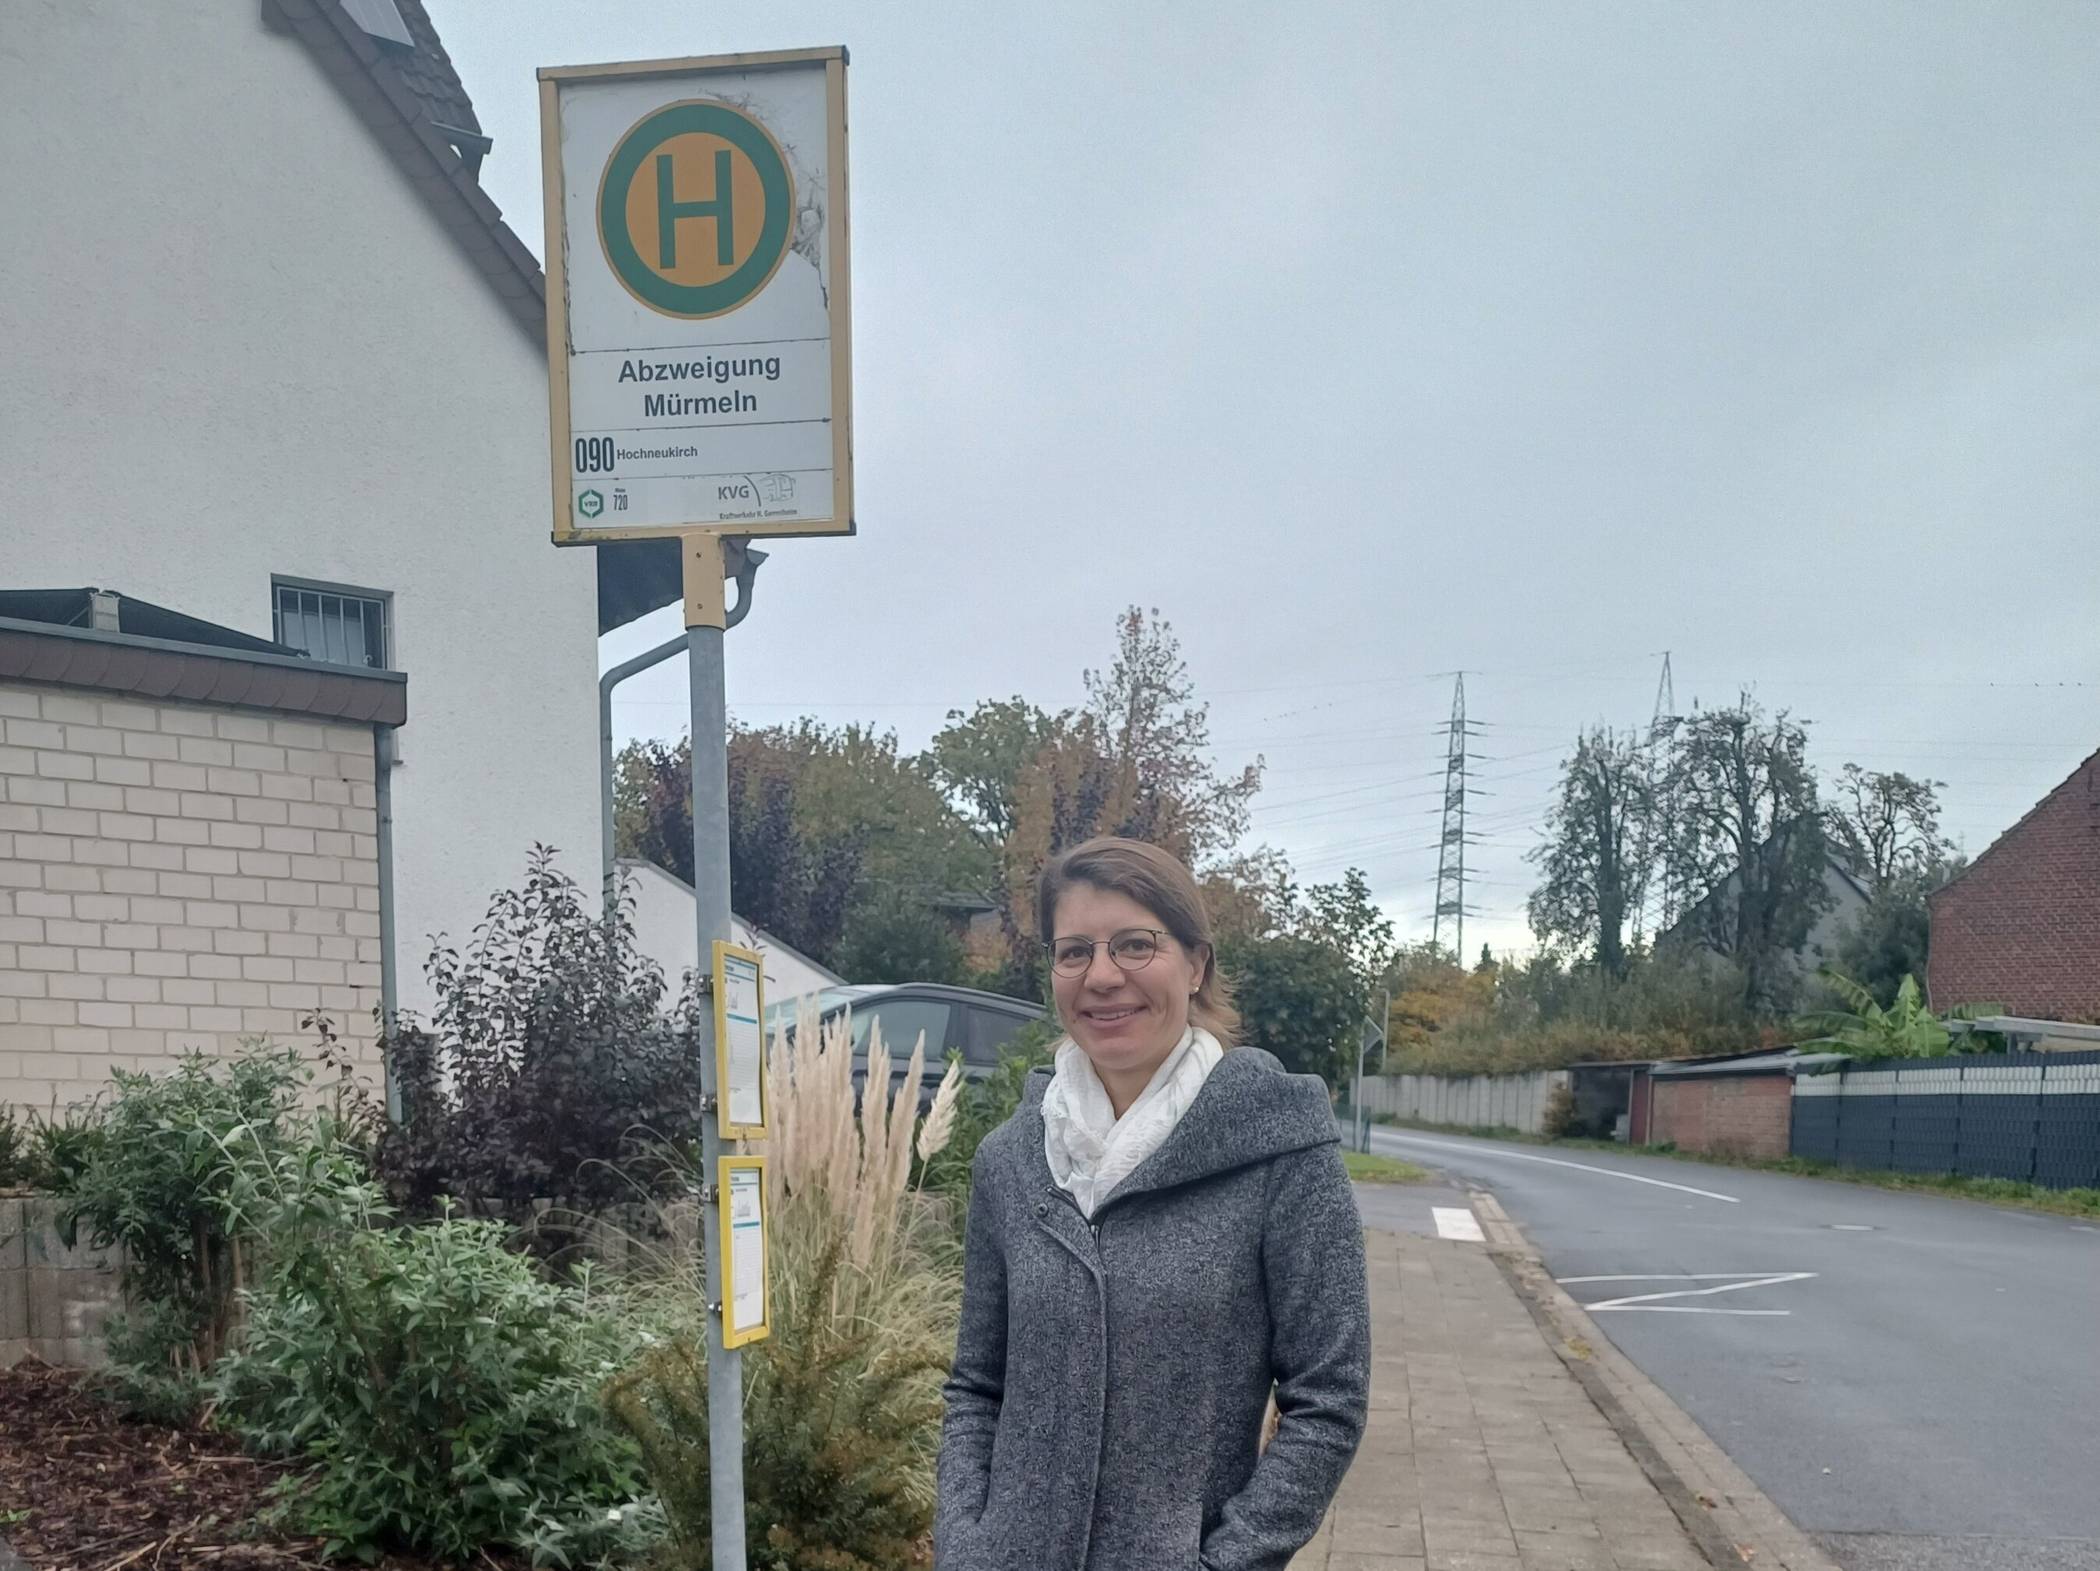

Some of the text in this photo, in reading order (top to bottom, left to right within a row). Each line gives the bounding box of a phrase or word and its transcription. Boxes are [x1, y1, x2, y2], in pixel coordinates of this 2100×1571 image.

[657, 150, 734, 269] H
[618, 356, 780, 383] Abzweigung
[644, 390, 757, 417] Mürmeln
[575, 437, 698, 473] 090 Hochneukirch
[613, 494, 628, 511] 720
[718, 485, 749, 500] KVG
